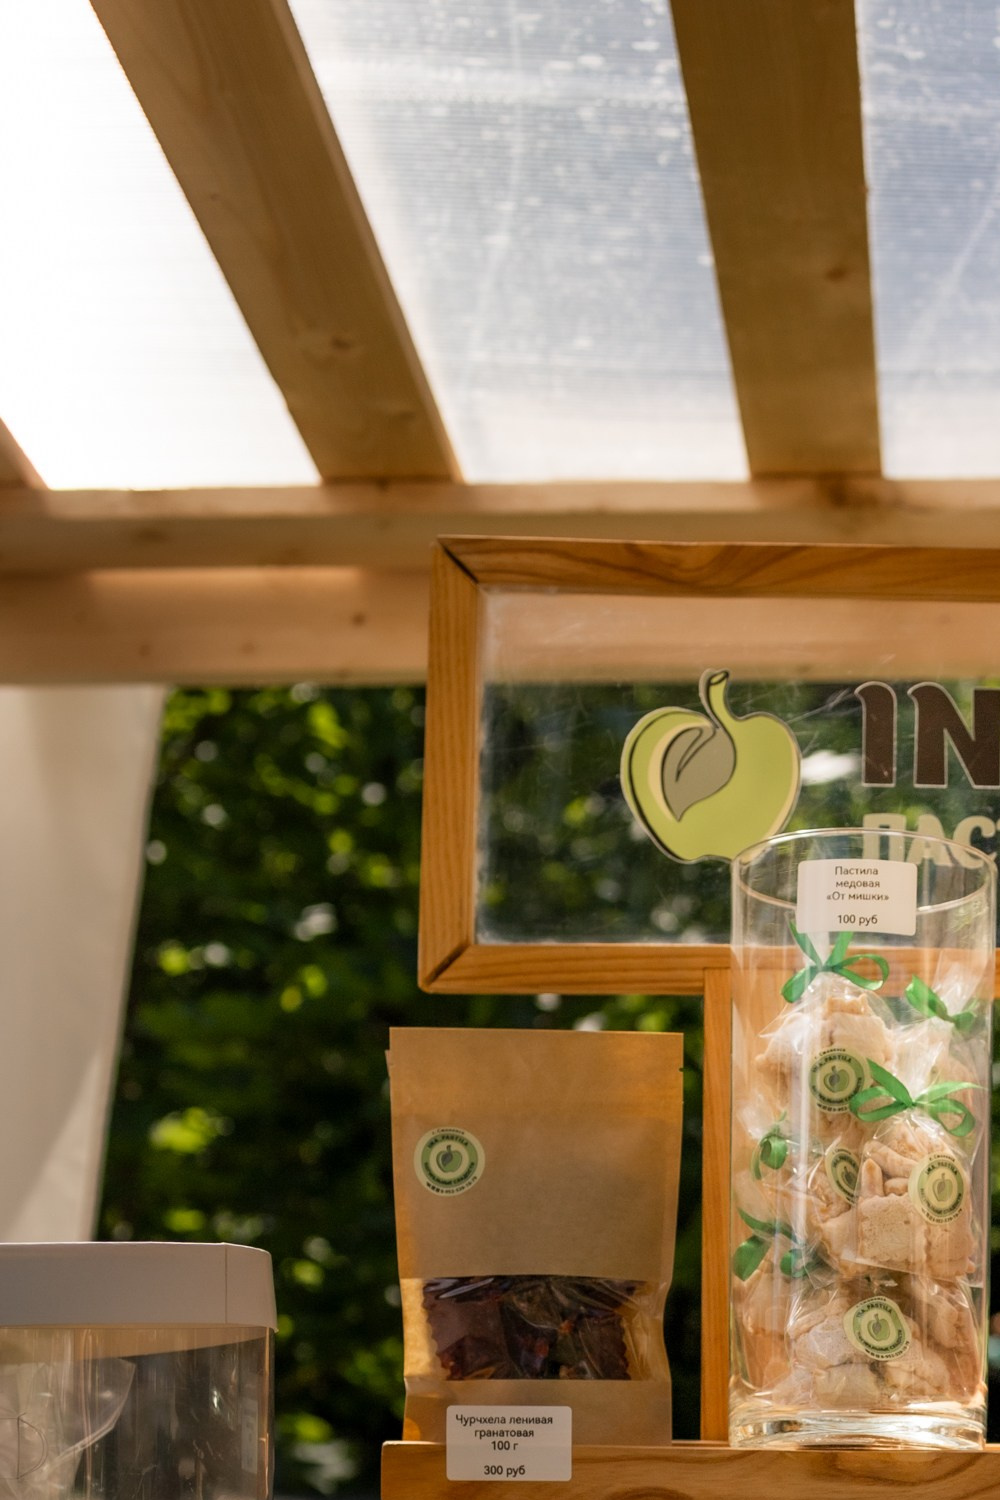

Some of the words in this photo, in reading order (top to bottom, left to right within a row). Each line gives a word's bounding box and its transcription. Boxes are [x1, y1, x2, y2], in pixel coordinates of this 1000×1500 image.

[835, 866, 879, 876] Пастила
[835, 881, 880, 889] медовая
[826, 891, 846, 901] «От
[848, 893, 890, 901] мишки»
[838, 914, 856, 924] 100
[858, 914, 878, 926] руб
[455, 1414, 506, 1427] Чурчхела
[509, 1416, 553, 1424] ленивая
[474, 1429, 535, 1440] гранатовая
[491, 1441, 510, 1451] 100
[484, 1465, 503, 1475] 300
[506, 1465, 526, 1477] руб
